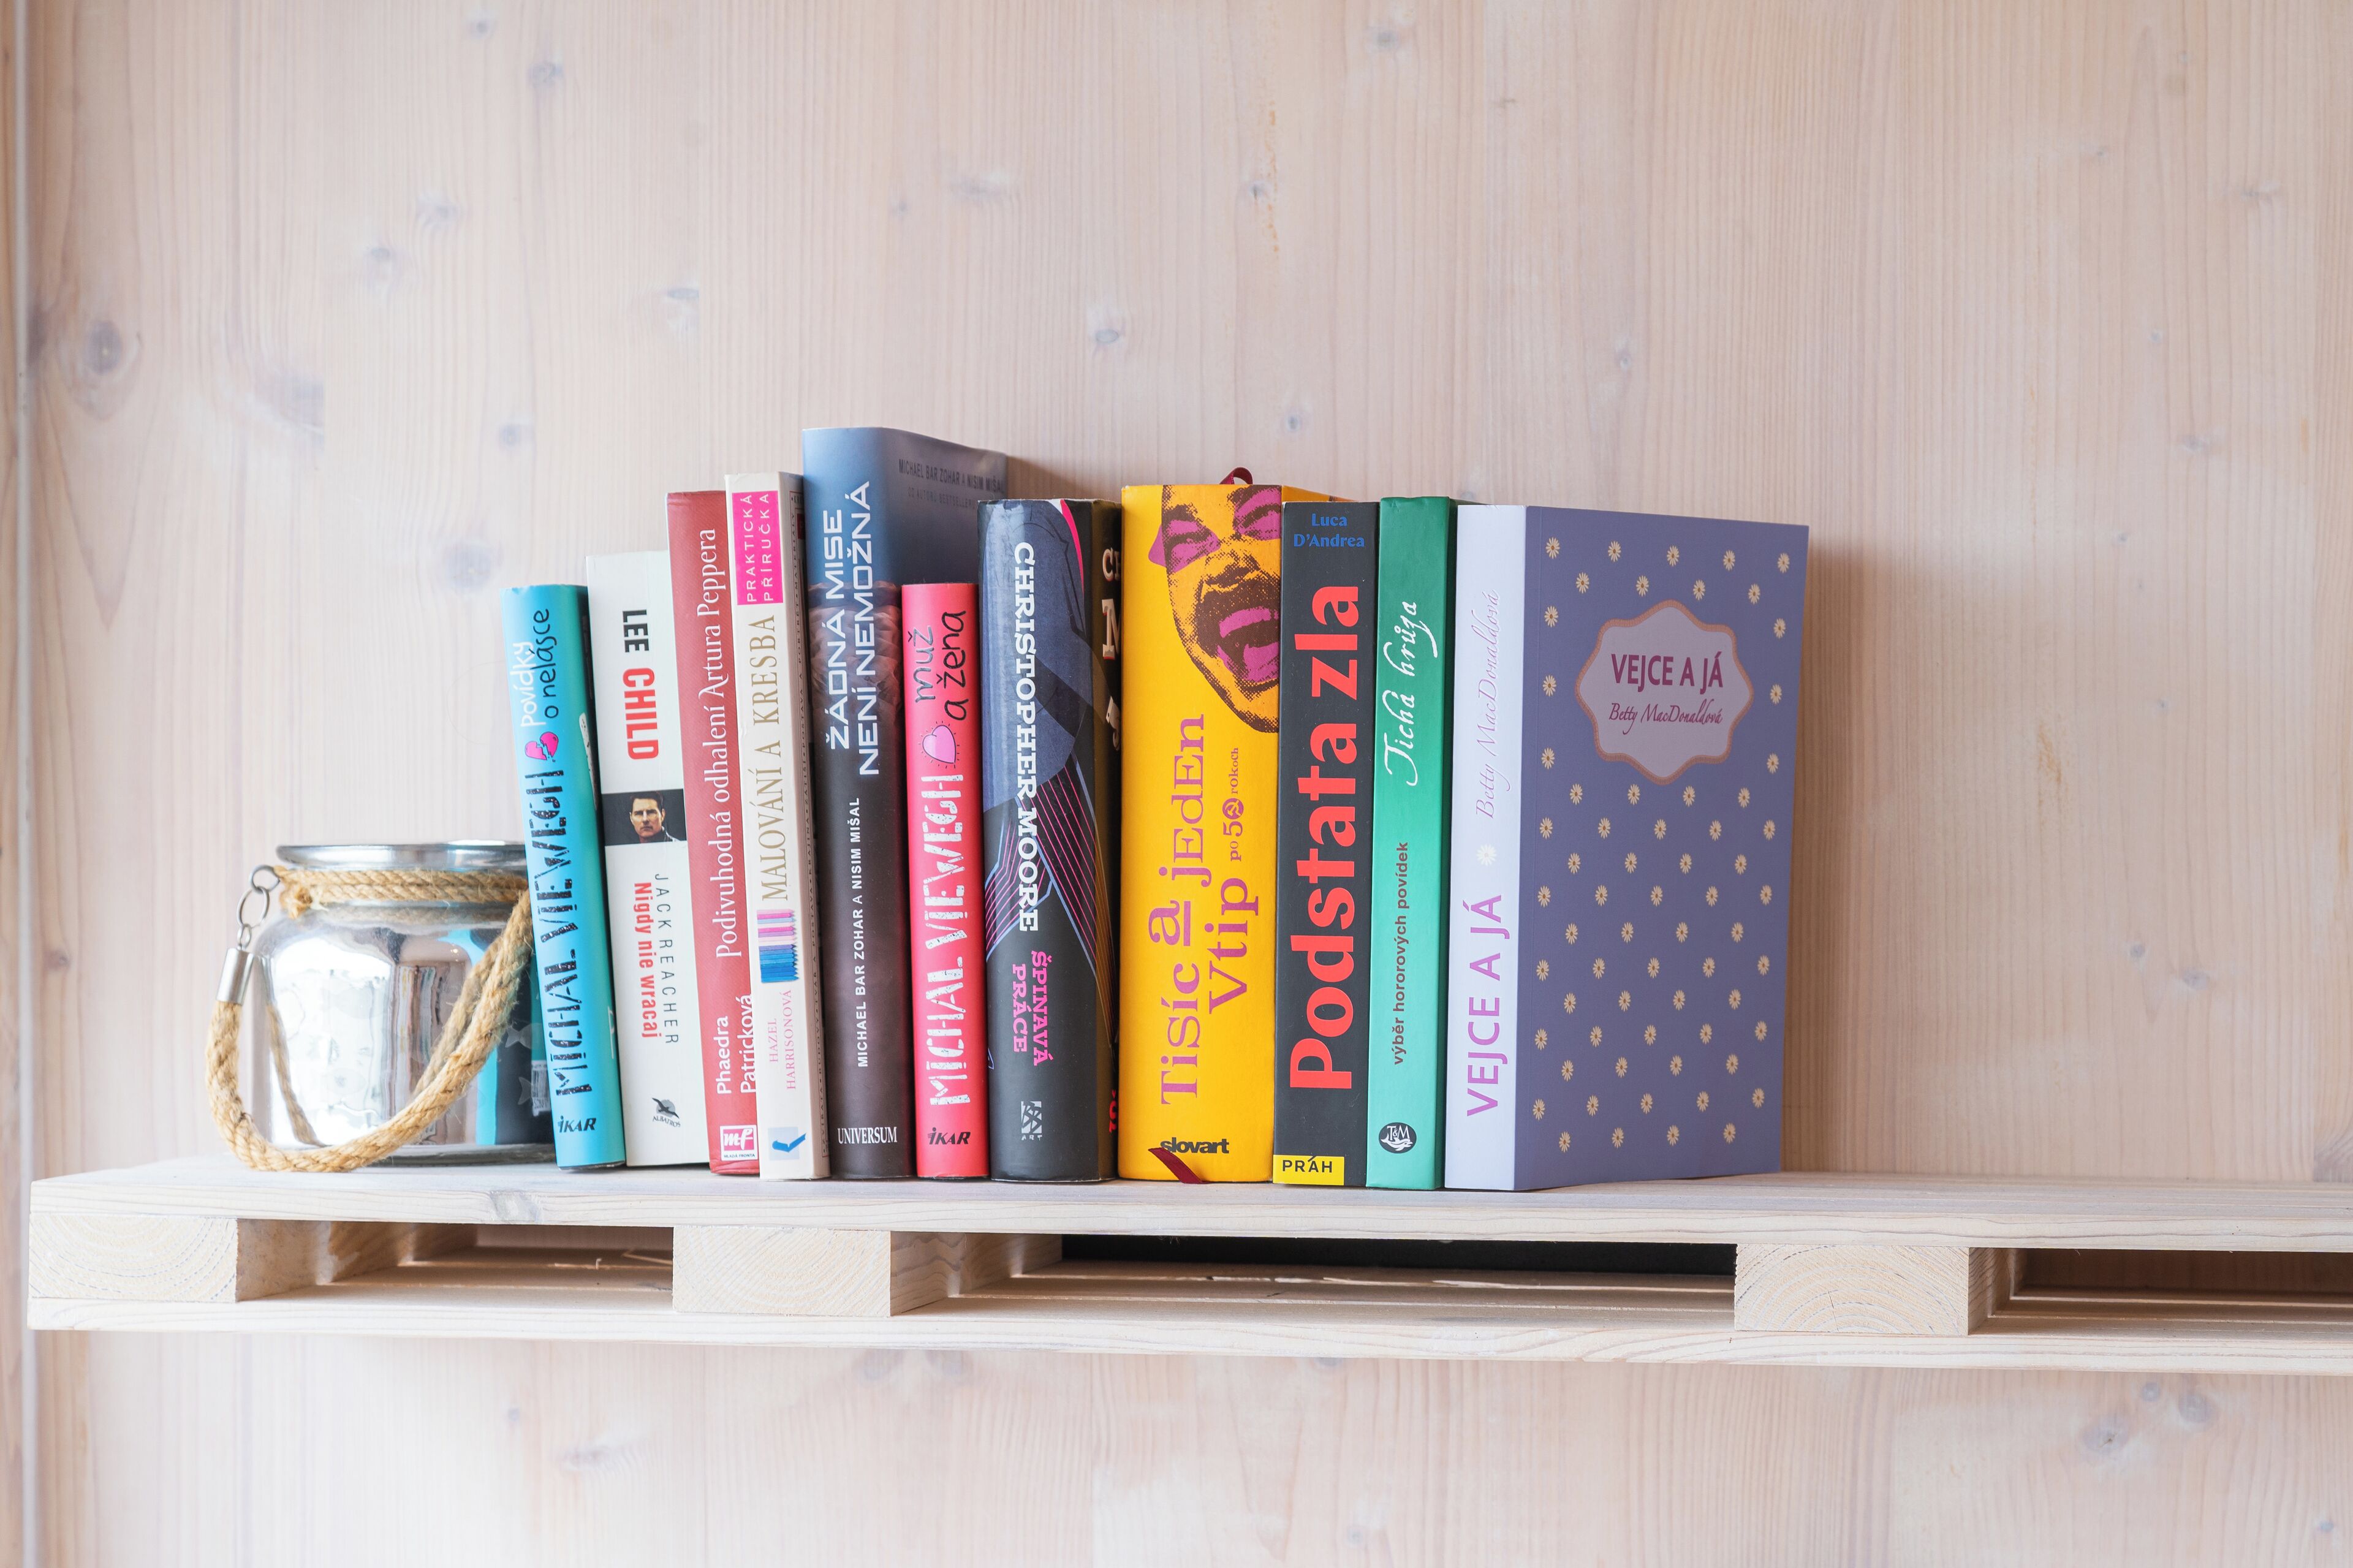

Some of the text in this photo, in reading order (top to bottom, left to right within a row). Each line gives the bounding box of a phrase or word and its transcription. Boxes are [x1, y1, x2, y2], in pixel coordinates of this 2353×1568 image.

[740, 494, 757, 602] PRAKTICKÁ
[758, 493, 775, 602] PŘÍRUČKA
[1294, 534, 1365, 548] D'Andrea
[1311, 513, 1347, 527] Luca
[529, 608, 559, 719] o nelásce
[822, 509, 850, 750] ŽÁDNÁ MISE
[844, 481, 879, 775] NENÍ NEMOŽNÁ
[907, 626, 936, 703] muž
[936, 610, 968, 721] a žena
[1611, 651, 1724, 694] VEJCE A JÁ
[621, 609, 659, 760] LEE CHILD
[1014, 542, 1039, 931] CHRISTOPHER MOORE
[1382, 601, 1438, 786] Tichá hrůza
[1471, 589, 1510, 819] Betty MacDonaldová
[1608, 699, 1724, 735] Betty MacDonaldová
[697, 528, 741, 959] Podivuhodná odhalení Artura Peppera
[748, 615, 788, 901] MALOVÁNÍ A KRESBA
[1230, 841, 1241, 862] po
[1290, 585, 1359, 1089] Podstata zla
[525, 770, 592, 1096] MICHAL VIEWEGH
[634, 882, 662, 1039] Nigdy nie wracaj
[654, 874, 679, 1045] JACK REACHER
[847, 797, 868, 1067] MICHAEL BAR ZOHAR A NISIM MIŠAL
[921, 773, 971, 1105] MICHAL VIEWEGH
[1148, 900, 1180, 946] a
[1205, 878, 1259, 1014] Vtip
[1392, 841, 1410, 1066] výběr hororových povídek
[716, 1016, 729, 1094] Phaedra
[735, 993, 757, 1094] Patricková
[768, 1018, 778, 1062] HAZEL
[779, 989, 796, 1089] HARRISONOVÁ
[1012, 963, 1031, 1053] PRÁCE
[1031, 950, 1054, 1066] ŠPINAVÁ
[1463, 895, 1510, 1116] VEJCE A JÁ
[653, 1115, 681, 1127] ALBATROS
[838, 1126, 897, 1144] UNIVERSUM
[1160, 1137, 1229, 1154] slovart
[1282, 1155, 1332, 1173] PRÁH
[1387, 1125, 1410, 1140] T&M
